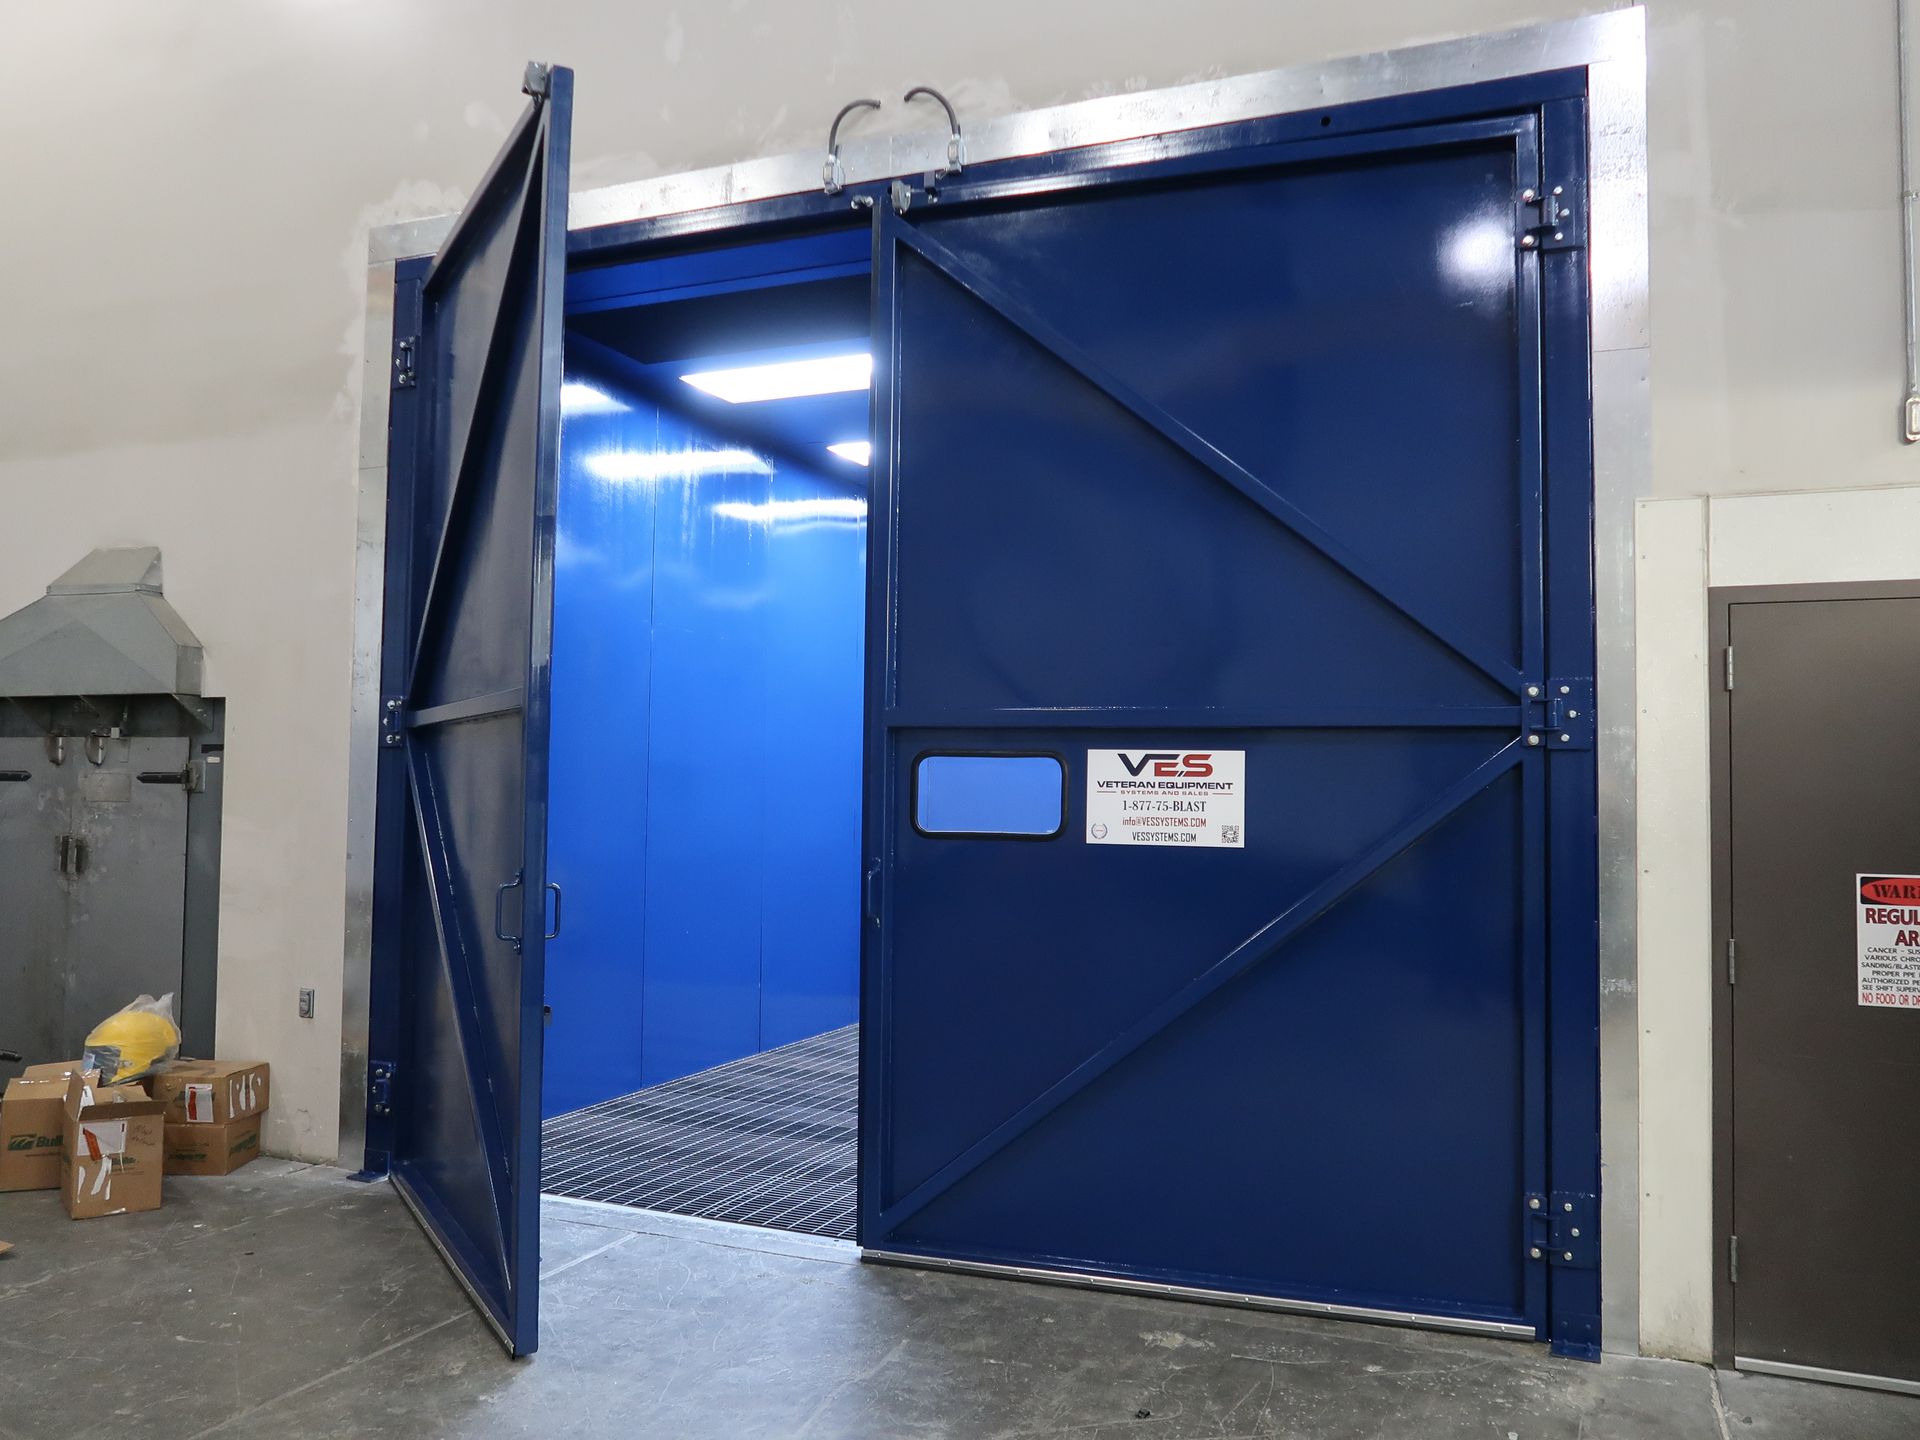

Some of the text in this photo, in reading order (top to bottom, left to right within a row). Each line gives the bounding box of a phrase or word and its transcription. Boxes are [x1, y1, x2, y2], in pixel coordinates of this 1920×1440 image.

[1117, 753, 1213, 777] VES
[1097, 781, 1233, 790] VETERAN EQUIPMENT
[1123, 800, 1206, 812] 1-877-75-BLAST
[1132, 832, 1196, 842] VESSYSTEMS.COM
[1872, 884, 1920, 899] WAR
[1862, 977, 1909, 985] AUTHORIZED
[1862, 992, 1873, 1003] NO
[1876, 993, 1896, 1005] FOOD
[1899, 994, 1909, 1005] OR
